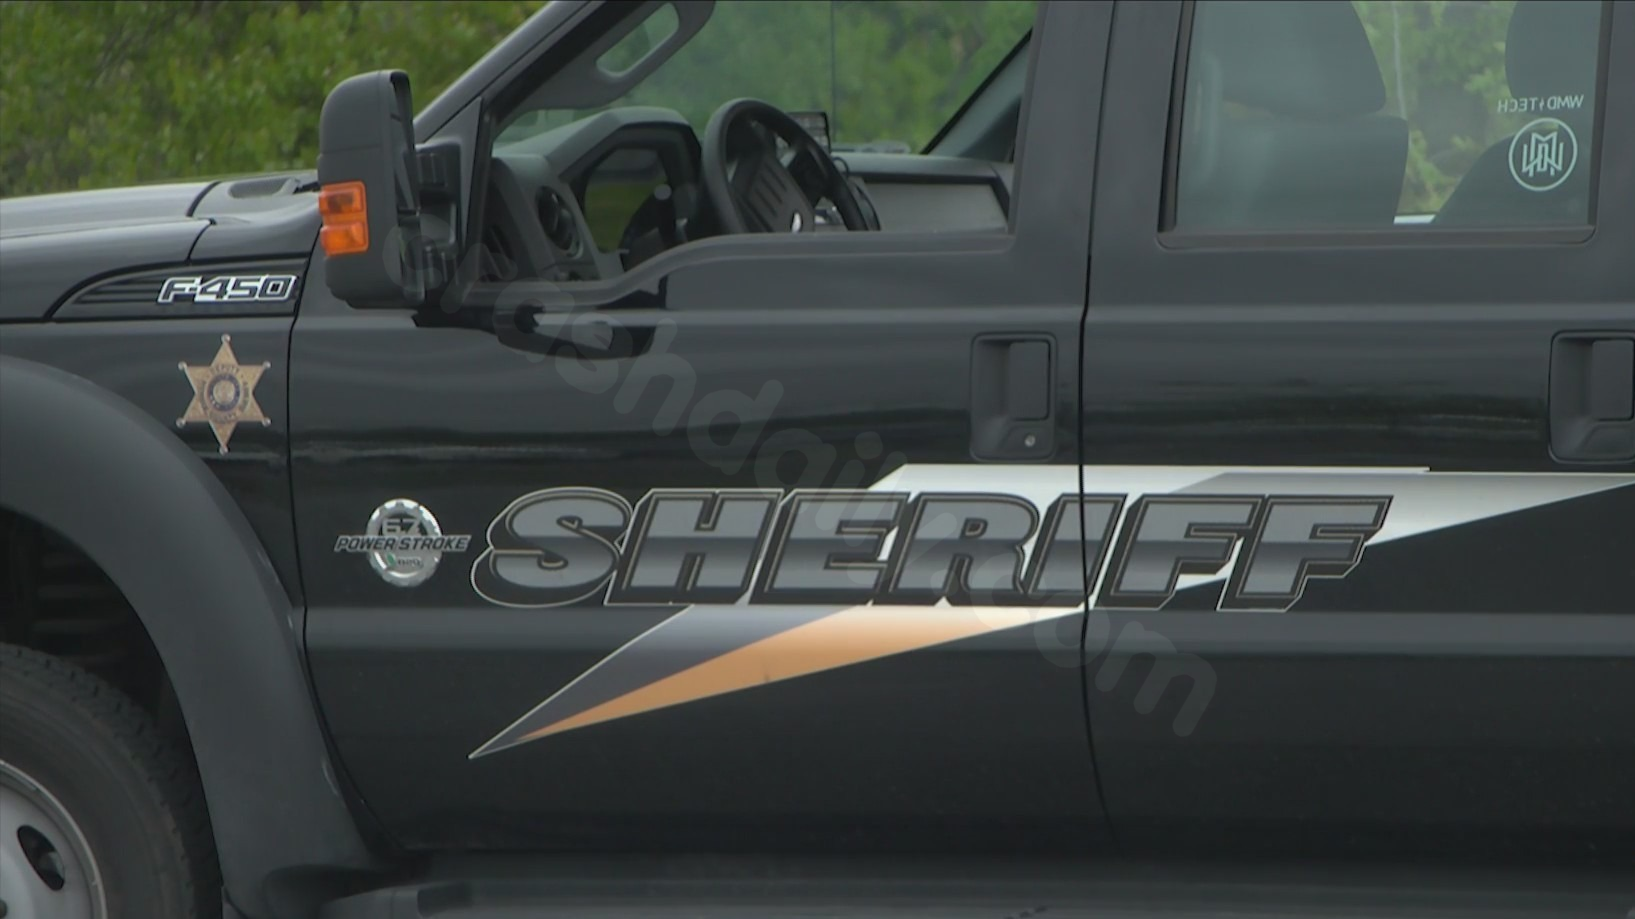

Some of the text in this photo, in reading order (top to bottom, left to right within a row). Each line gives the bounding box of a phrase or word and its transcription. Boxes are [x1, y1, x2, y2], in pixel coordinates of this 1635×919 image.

[157, 274, 297, 303] F-450
[334, 535, 471, 551] POWER STROKE
[470, 487, 1394, 612] SHERIFF
